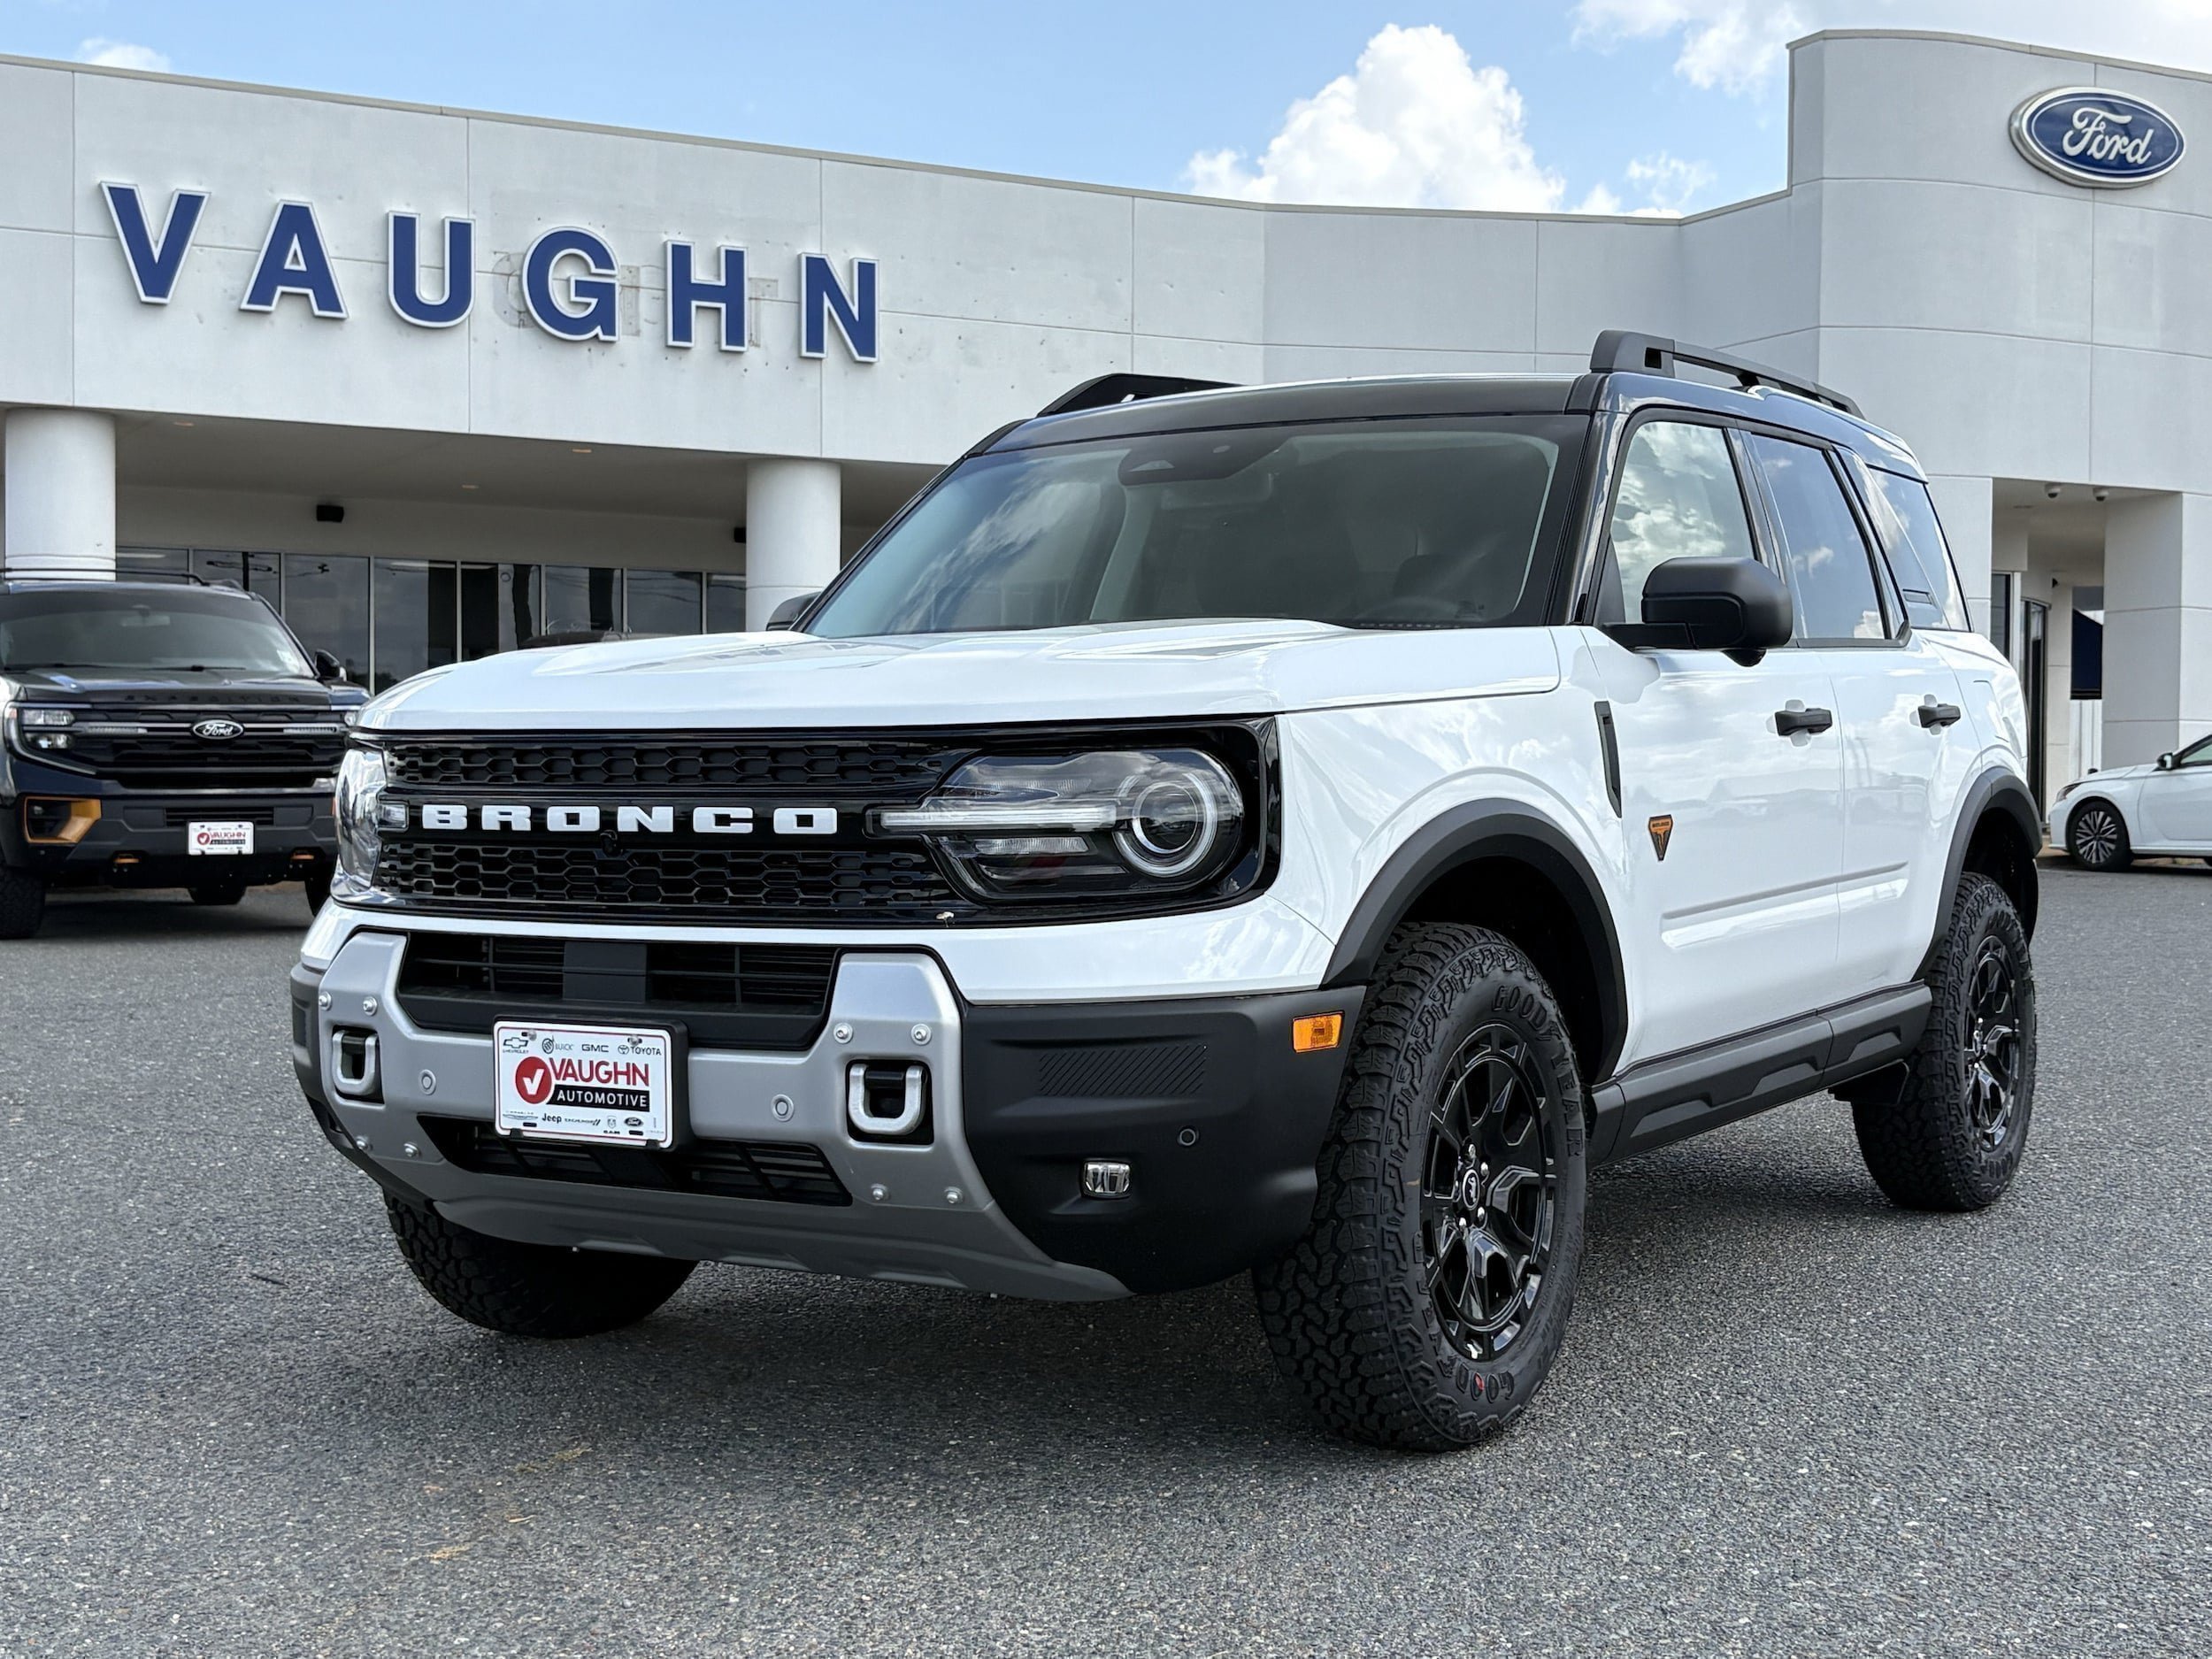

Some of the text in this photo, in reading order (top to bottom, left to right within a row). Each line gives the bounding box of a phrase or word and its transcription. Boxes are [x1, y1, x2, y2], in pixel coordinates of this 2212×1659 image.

[2062, 107, 2154, 165] Ford
[101, 181, 879, 364] VAUGHN
[202, 723, 234, 736] Ford
[422, 804, 838, 834] BRONCO
[581, 1043, 610, 1053] GMC
[630, 1047, 662, 1056] TOYOTA
[549, 1057, 649, 1087] VAUGHN
[1492, 984, 1585, 1158] GOODYEAR
[557, 1089, 648, 1107] AUTOMOTIVE
[541, 1113, 562, 1124] Jeep
